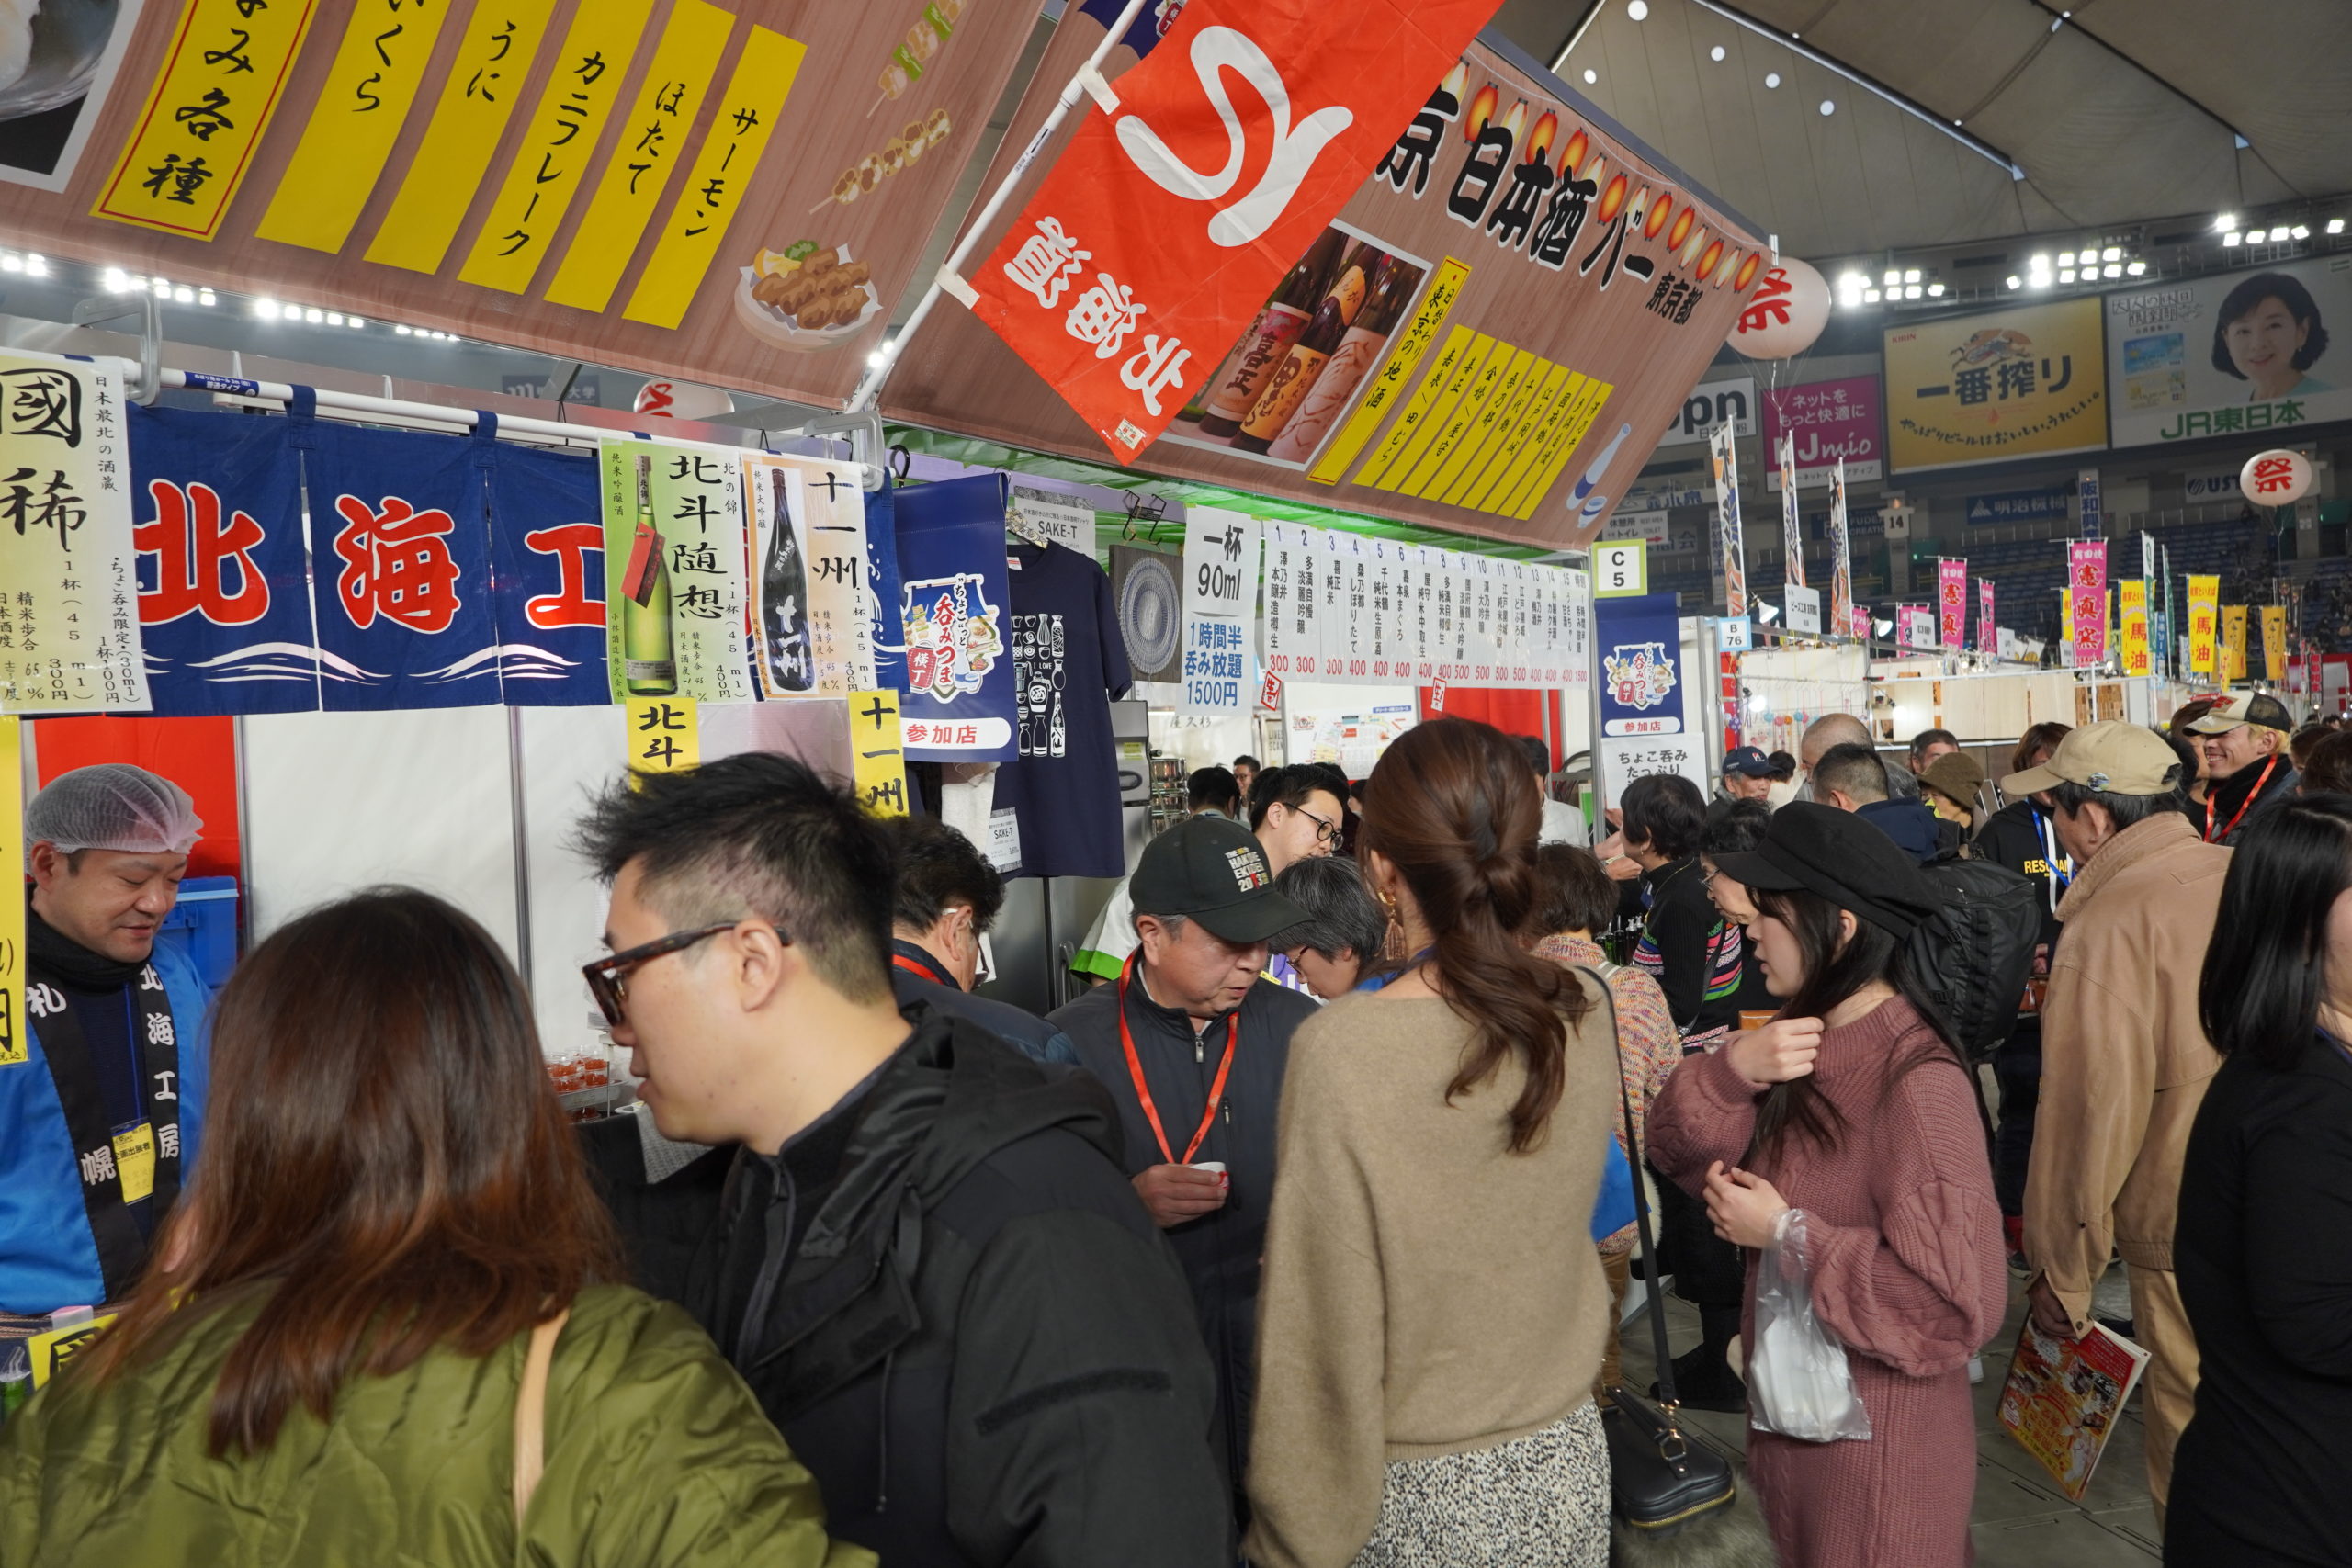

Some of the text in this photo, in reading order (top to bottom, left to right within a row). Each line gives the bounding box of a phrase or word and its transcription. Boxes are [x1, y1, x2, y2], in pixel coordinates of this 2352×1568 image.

[466, 19, 516, 103] うに
[628, 80, 687, 195] ほたて
[497, 51, 606, 257] カニフレーク
[684, 107, 759, 238] サーモン
[1645, 271, 1703, 325] 東京都
[1366, 283, 1445, 409] 東京の地酒
[1892, 332, 1917, 344] KIRIN
[1917, 355, 2072, 406] 一番搾り
[1792, 389, 1848, 409] ネットを
[1780, 404, 1866, 428] もっと快適に
[2161, 399, 2306, 440] JR東日本
[94, 376, 119, 492] 日本最北の酒蔵
[611, 452, 624, 516] 純米吟醸酒
[2254, 458, 2293, 493] 祭
[723, 462, 738, 515] 北の錦
[752, 470, 766, 530] 純米大吟醸
[808, 471, 857, 589] 十一州
[1038, 520, 1077, 539] SAKE-T
[1889, 515, 1904, 529] 14
[669, 455, 729, 619] 北斗随想
[1276, 525, 1281, 541] 1
[1301, 529, 1308, 546] 2
[1617, 528, 1638, 538] トイレ
[1204, 525, 1244, 562] 一杯
[1329, 535, 1335, 551] 3
[1352, 539, 1359, 556] 4
[1377, 543, 1383, 558] 5
[1398, 546, 1405, 561] 6
[1420, 549, 1425, 565] 7
[1441, 553, 1446, 569] 8
[1611, 551, 1624, 566] C
[1461, 557, 1466, 571] 9
[1477, 559, 1487, 574] 10
[1497, 562, 1505, 577] 11
[1513, 565, 1522, 579] 12
[1197, 563, 1242, 601] 90ml
[1613, 571, 1625, 587] 5
[1327, 574, 1334, 606] 純米
[17, 591, 40, 651] 精米歩合
[1730, 625, 1738, 633] B
[934, 595, 957, 684] 呑みつま
[1191, 622, 1243, 650] 1時間半
[1727, 637, 1742, 646] 76
[2195, 616, 2211, 662] 馬油
[2131, 622, 2147, 670] 馬油
[911, 651, 929, 683] 横丁
[1185, 650, 1243, 679] 呑み放題
[1270, 654, 1288, 672] 300
[1296, 656, 1315, 673] 300
[1326, 658, 1342, 675] 300
[1349, 660, 1366, 676] 400
[1374, 660, 1388, 677] 400
[1395, 661, 1410, 678] 400
[1419, 662, 1432, 678] 400
[1438, 663, 1452, 679] 400
[1454, 664, 1470, 680] 500
[49, 658, 68, 700] 300円
[716, 664, 731, 698] 400円
[1475, 665, 1490, 680] 500
[1495, 666, 1509, 681] 500
[1513, 667, 1526, 681] 500
[1531, 668, 1541, 682] 400
[1545, 669, 1557, 682] 400
[1634, 653, 1647, 700] 呑みつま
[1187, 680, 1238, 707] 1500円
[639, 703, 686, 768] 北斗
[907, 724, 978, 745] 参加店
[1624, 721, 1661, 733] 参加店
[860, 696, 904, 812] 十一州
[1618, 750, 1688, 765] ちょこ呑み
[1626, 763, 1680, 779] たっぷり
[139, 964, 179, 1159] 北海工房
